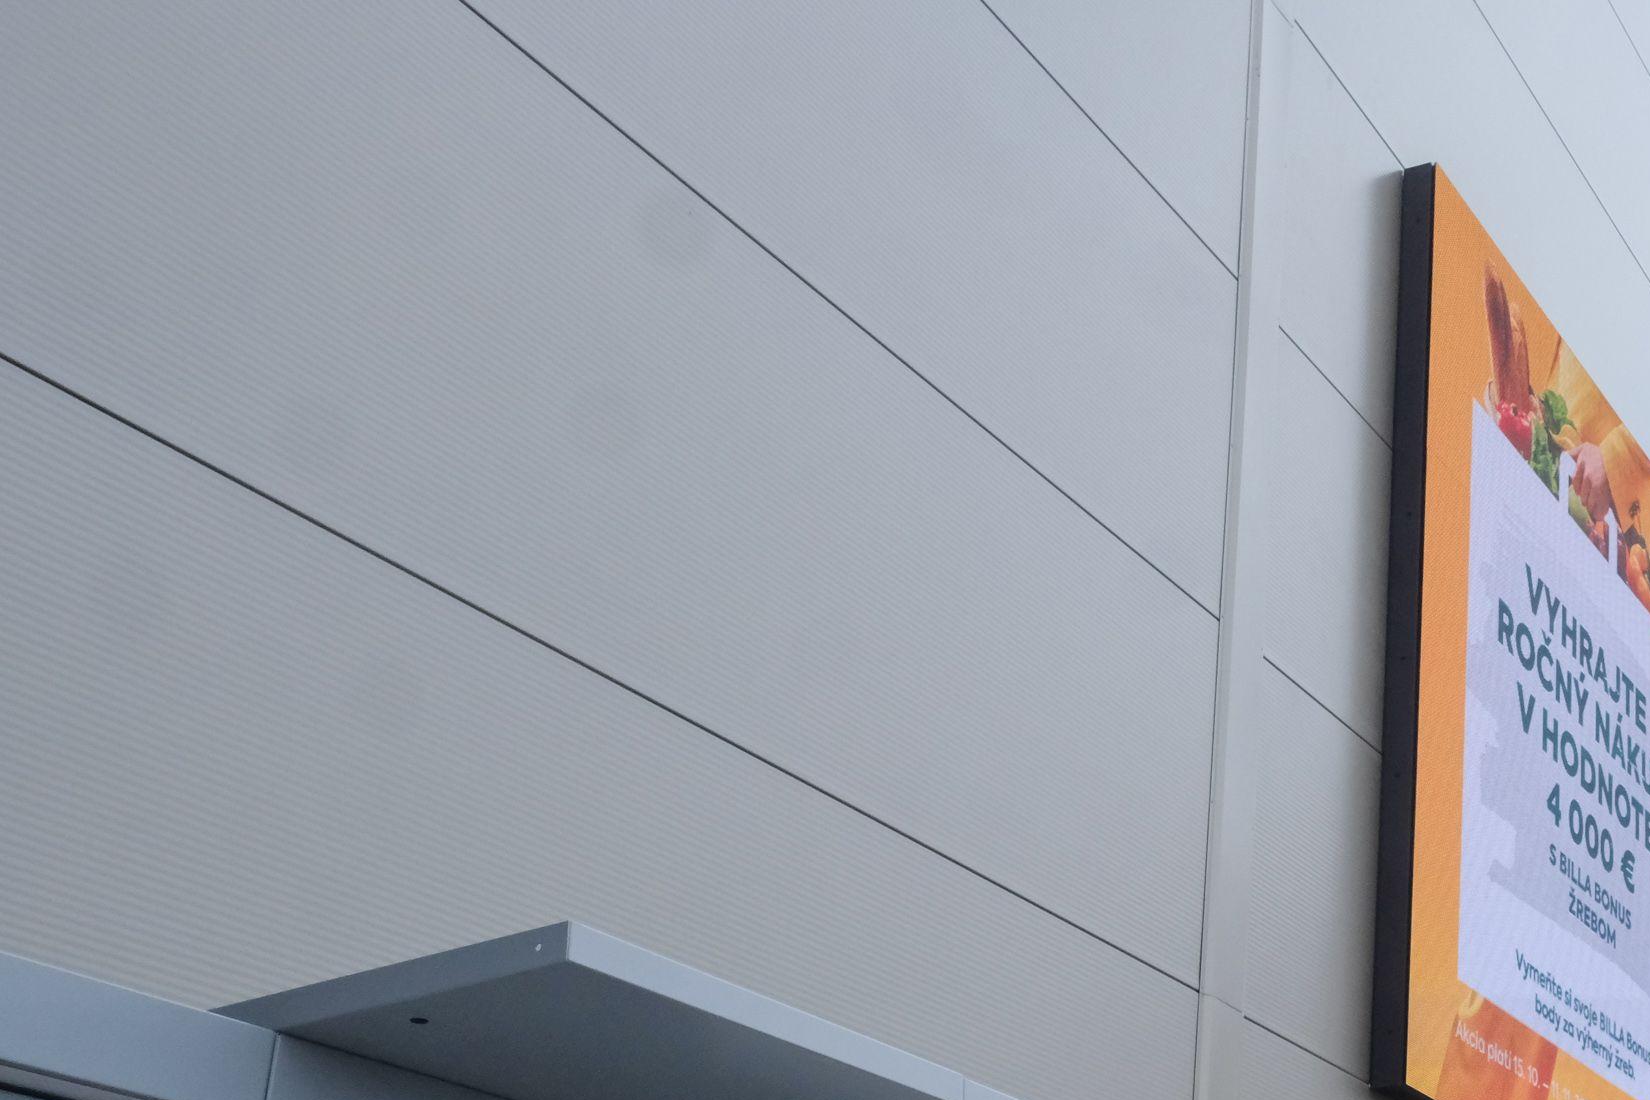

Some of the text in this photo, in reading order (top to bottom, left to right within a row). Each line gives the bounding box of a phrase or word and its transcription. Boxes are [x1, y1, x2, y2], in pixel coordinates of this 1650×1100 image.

[1498, 598, 1589, 726] ROČNÝ
[1525, 563, 1648, 736] VYHRAJTE
[1517, 680, 1536, 735] V
[1547, 782, 1636, 894] 4 000 €
[1549, 843, 1632, 930] S BILLA BONUS
[1568, 890, 1617, 949] ŽREBOM
[1516, 948, 1561, 1000] Vymeňte
[1564, 989, 1572, 1007] si
[1573, 999, 1598, 1027] svoje
[1599, 1011, 1626, 1046] BILLA
[1534, 994, 1636, 1081] body za výherný žreb.
[1456, 1021, 1485, 1054] Akcia
[1487, 1042, 1513, 1072] platí
[1513, 1055, 1524, 1080] 15.
[1527, 1065, 1541, 1089] 10.
